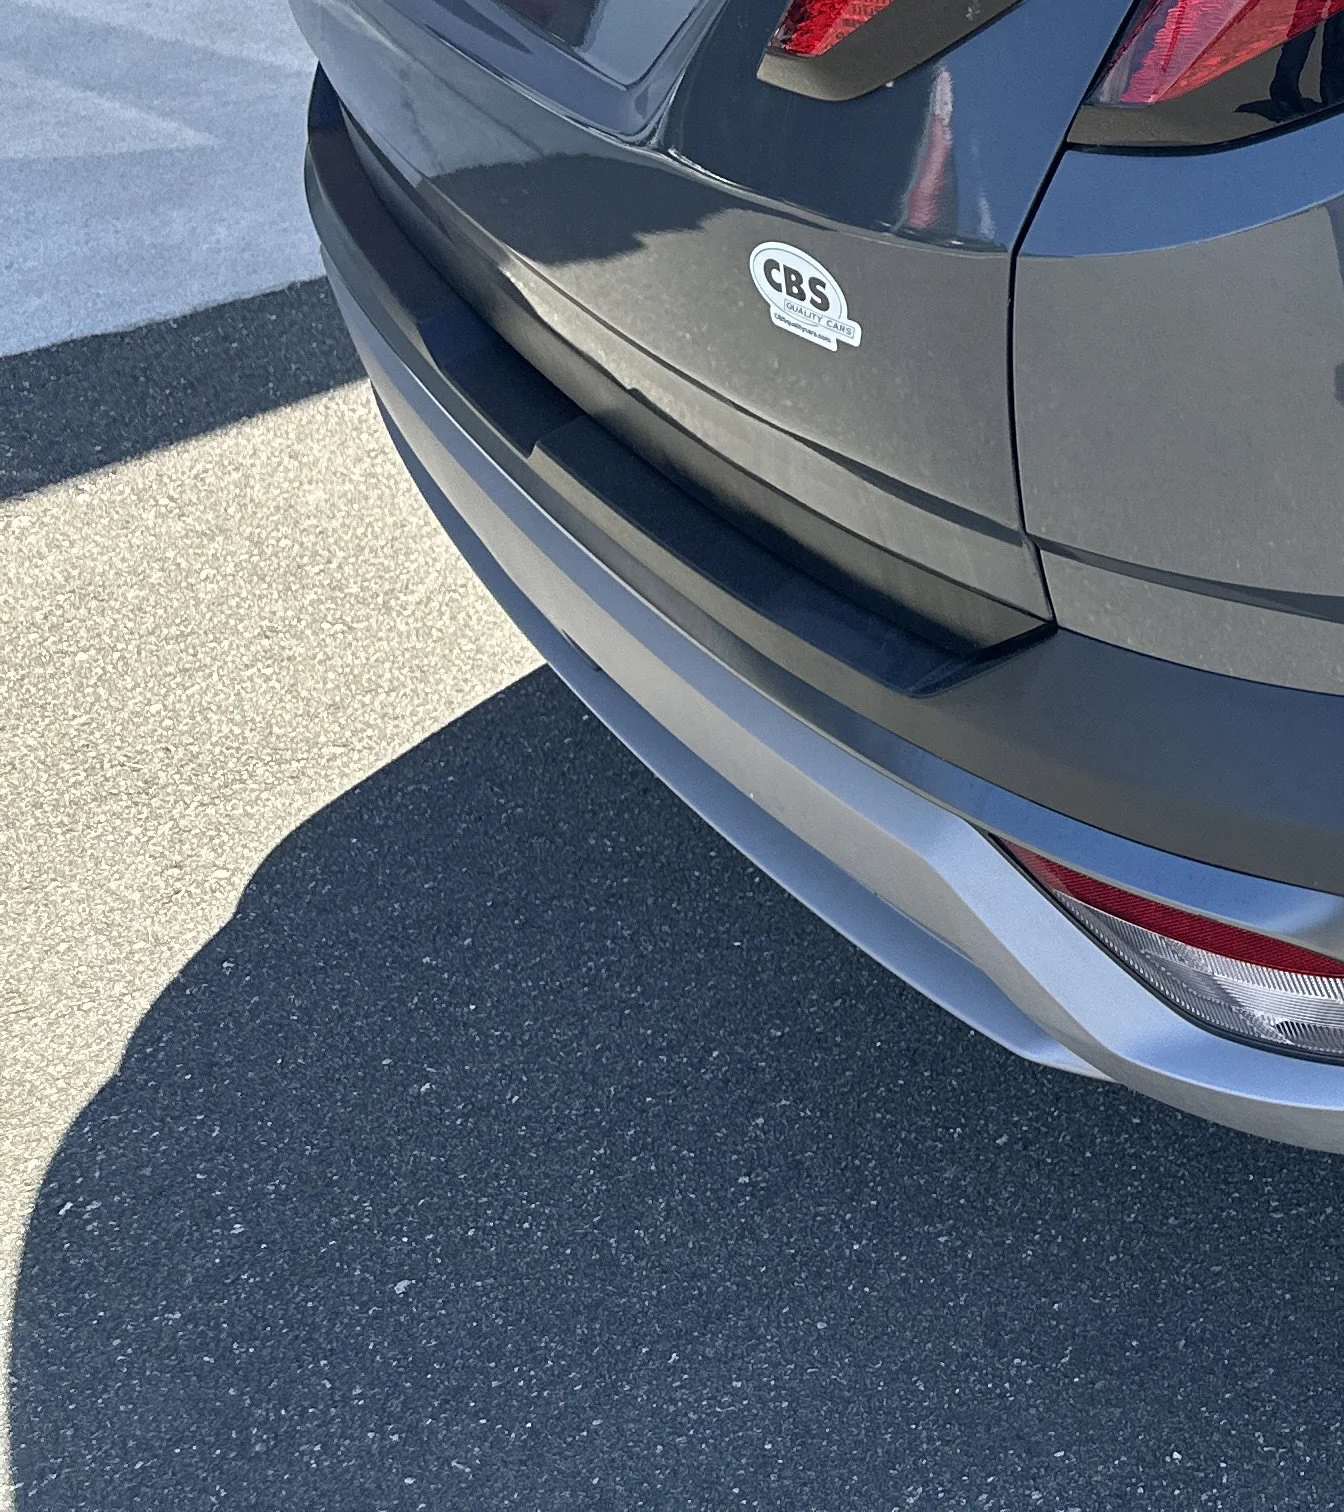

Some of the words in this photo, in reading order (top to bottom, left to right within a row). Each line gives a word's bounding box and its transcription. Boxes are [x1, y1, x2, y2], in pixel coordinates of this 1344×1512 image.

[763, 258, 830, 312] CBS
[786, 302, 823, 323] QUALITY
[826, 319, 852, 336] CARS
